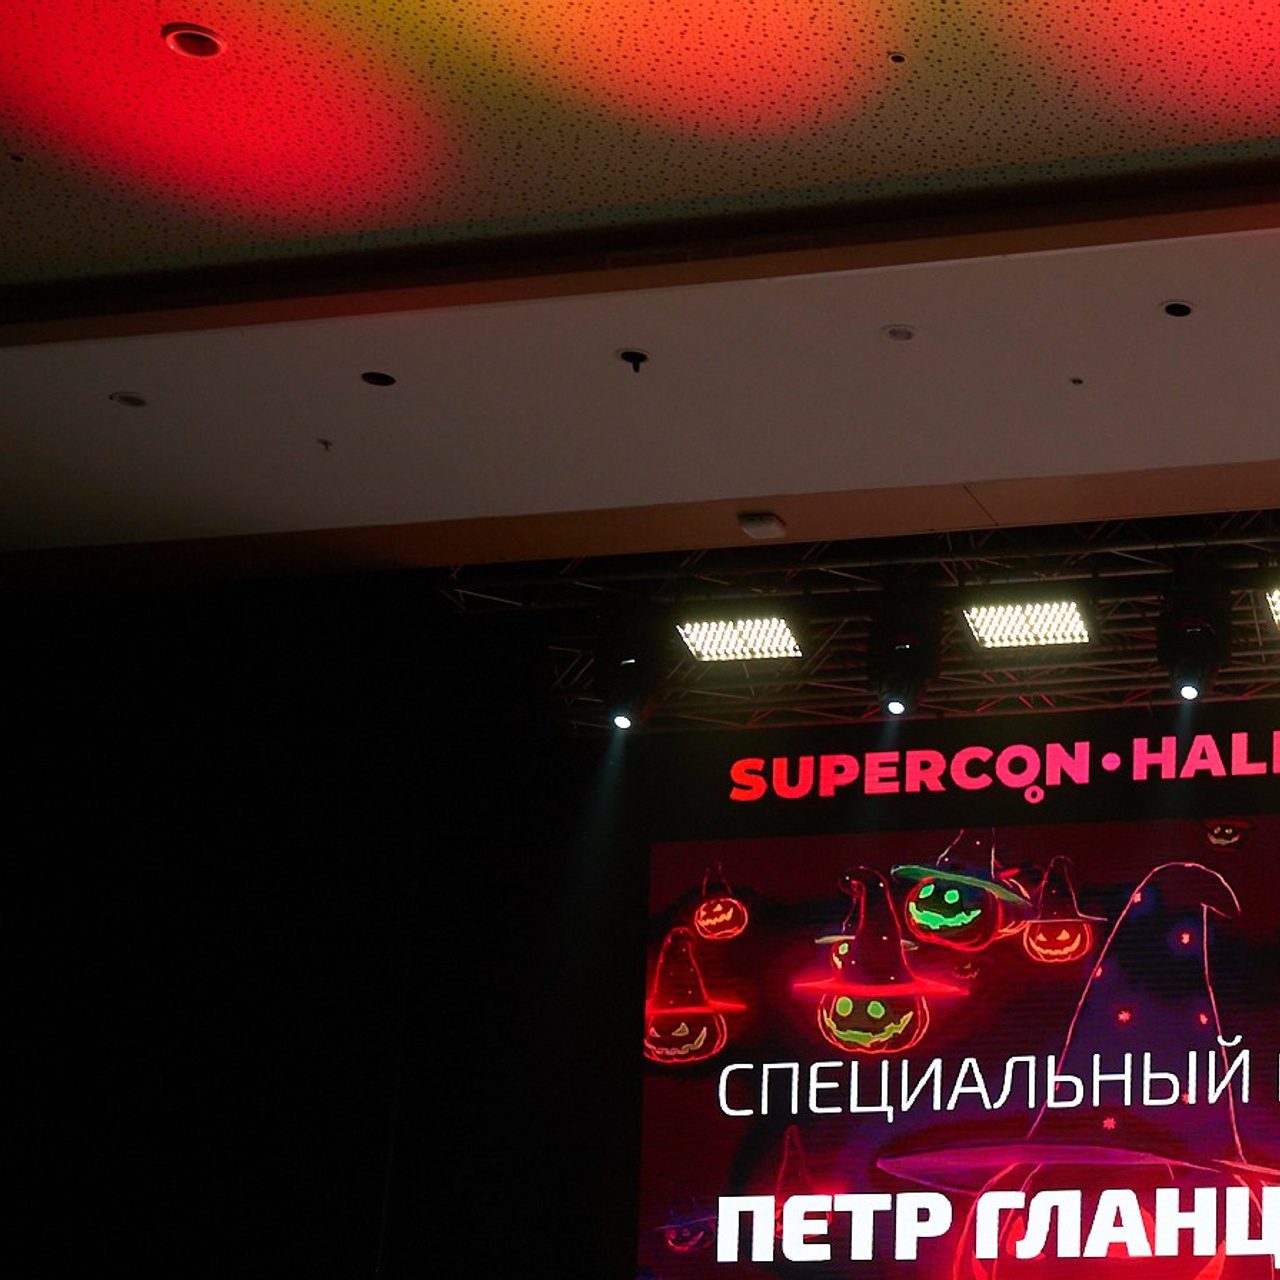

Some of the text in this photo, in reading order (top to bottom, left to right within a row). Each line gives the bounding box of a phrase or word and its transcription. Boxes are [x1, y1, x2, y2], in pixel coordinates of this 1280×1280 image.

[730, 741, 1090, 804] SUPERCON
[718, 1034, 1250, 1124] СПЕЦИАЛЬНЫЙ
[716, 1192, 953, 1263] ПЕТР
